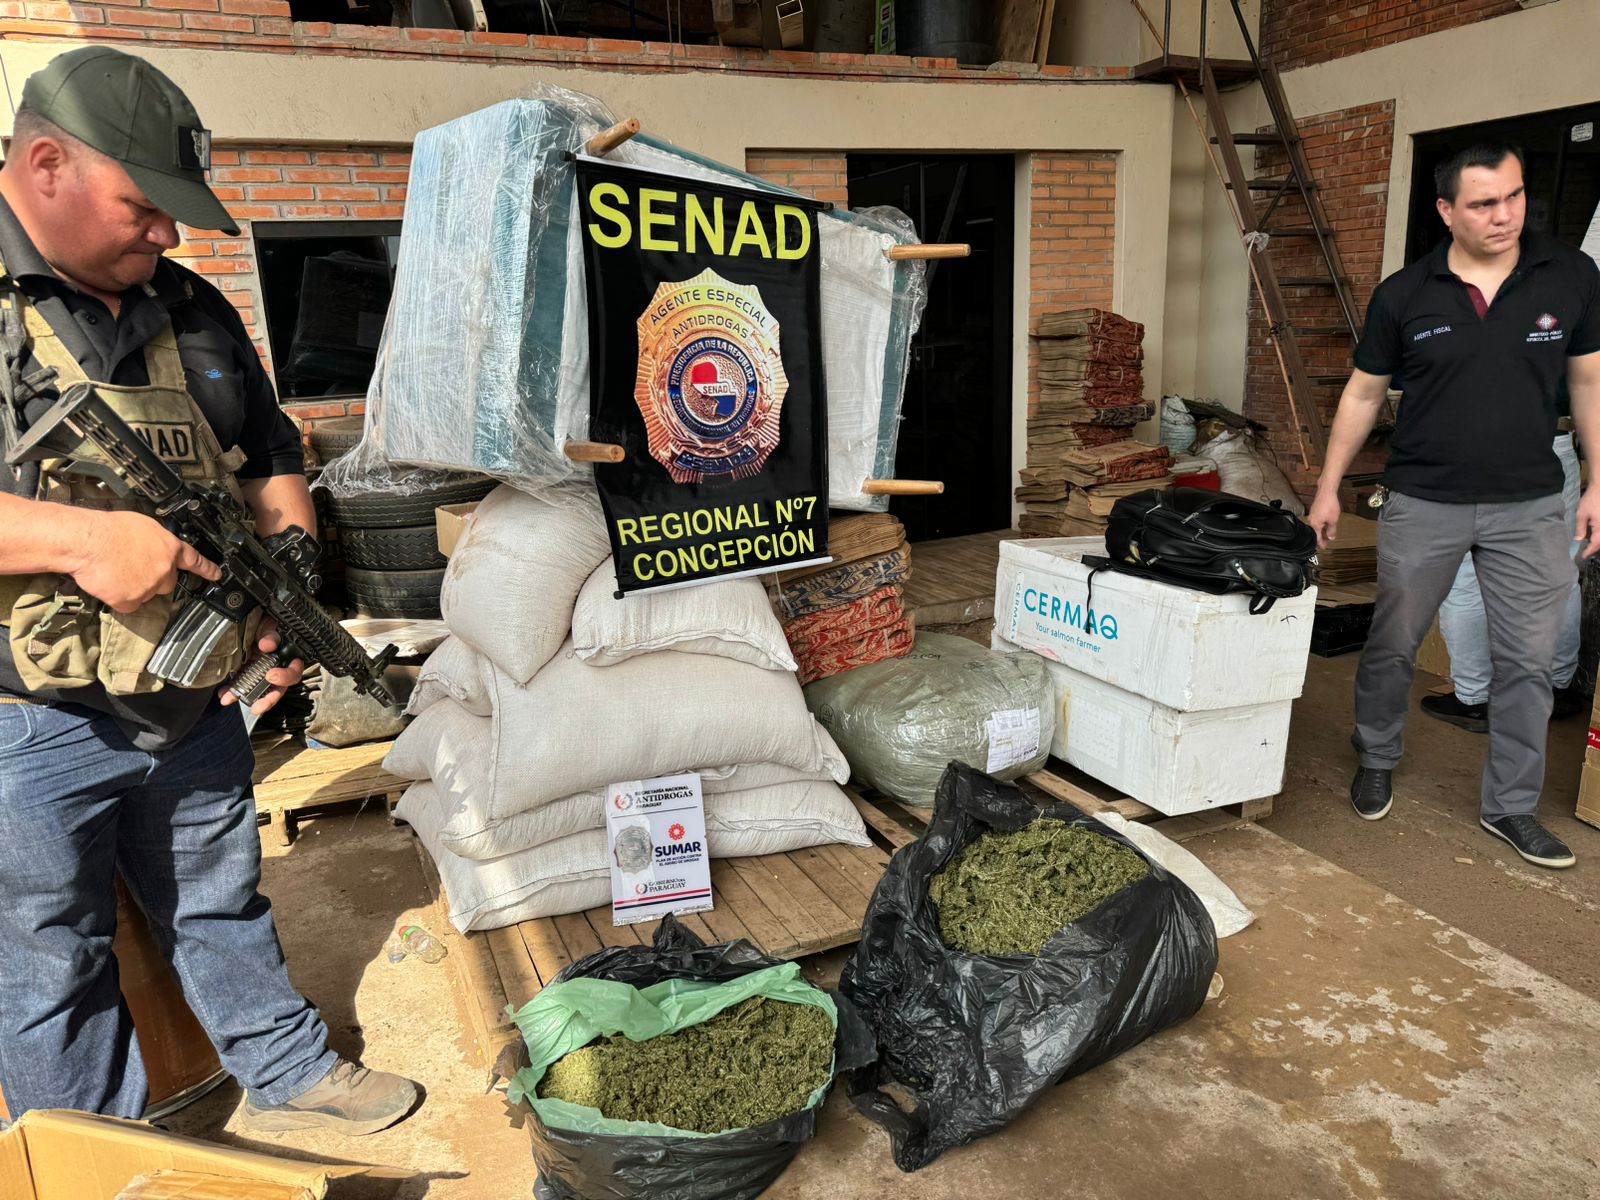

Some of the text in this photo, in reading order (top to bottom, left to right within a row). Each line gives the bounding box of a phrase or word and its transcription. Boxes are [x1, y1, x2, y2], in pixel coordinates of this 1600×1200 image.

[588, 182, 811, 260] SENAD
[650, 288, 767, 328] AGENTE ESPECIAL
[672, 314, 748, 339] ANTIDROGAS
[1433, 326, 1452, 337] FISCAL
[670, 340, 754, 386] PRESIDENCIA DE LA REPUBLICA
[703, 385, 728, 395] SENAD
[135, 427, 189, 458] NAD
[616, 503, 769, 546] REGIONAL
[633, 525, 815, 581] CONCEPCIÓN
[1023, 588, 1118, 641] CERMAQ
[1035, 622, 1101, 653] Your salmon farmer
[635, 790, 693, 804] ANTIDROGAS
[654, 841, 702, 857] SUMAR
[649, 881, 687, 893] PARAGUAY
